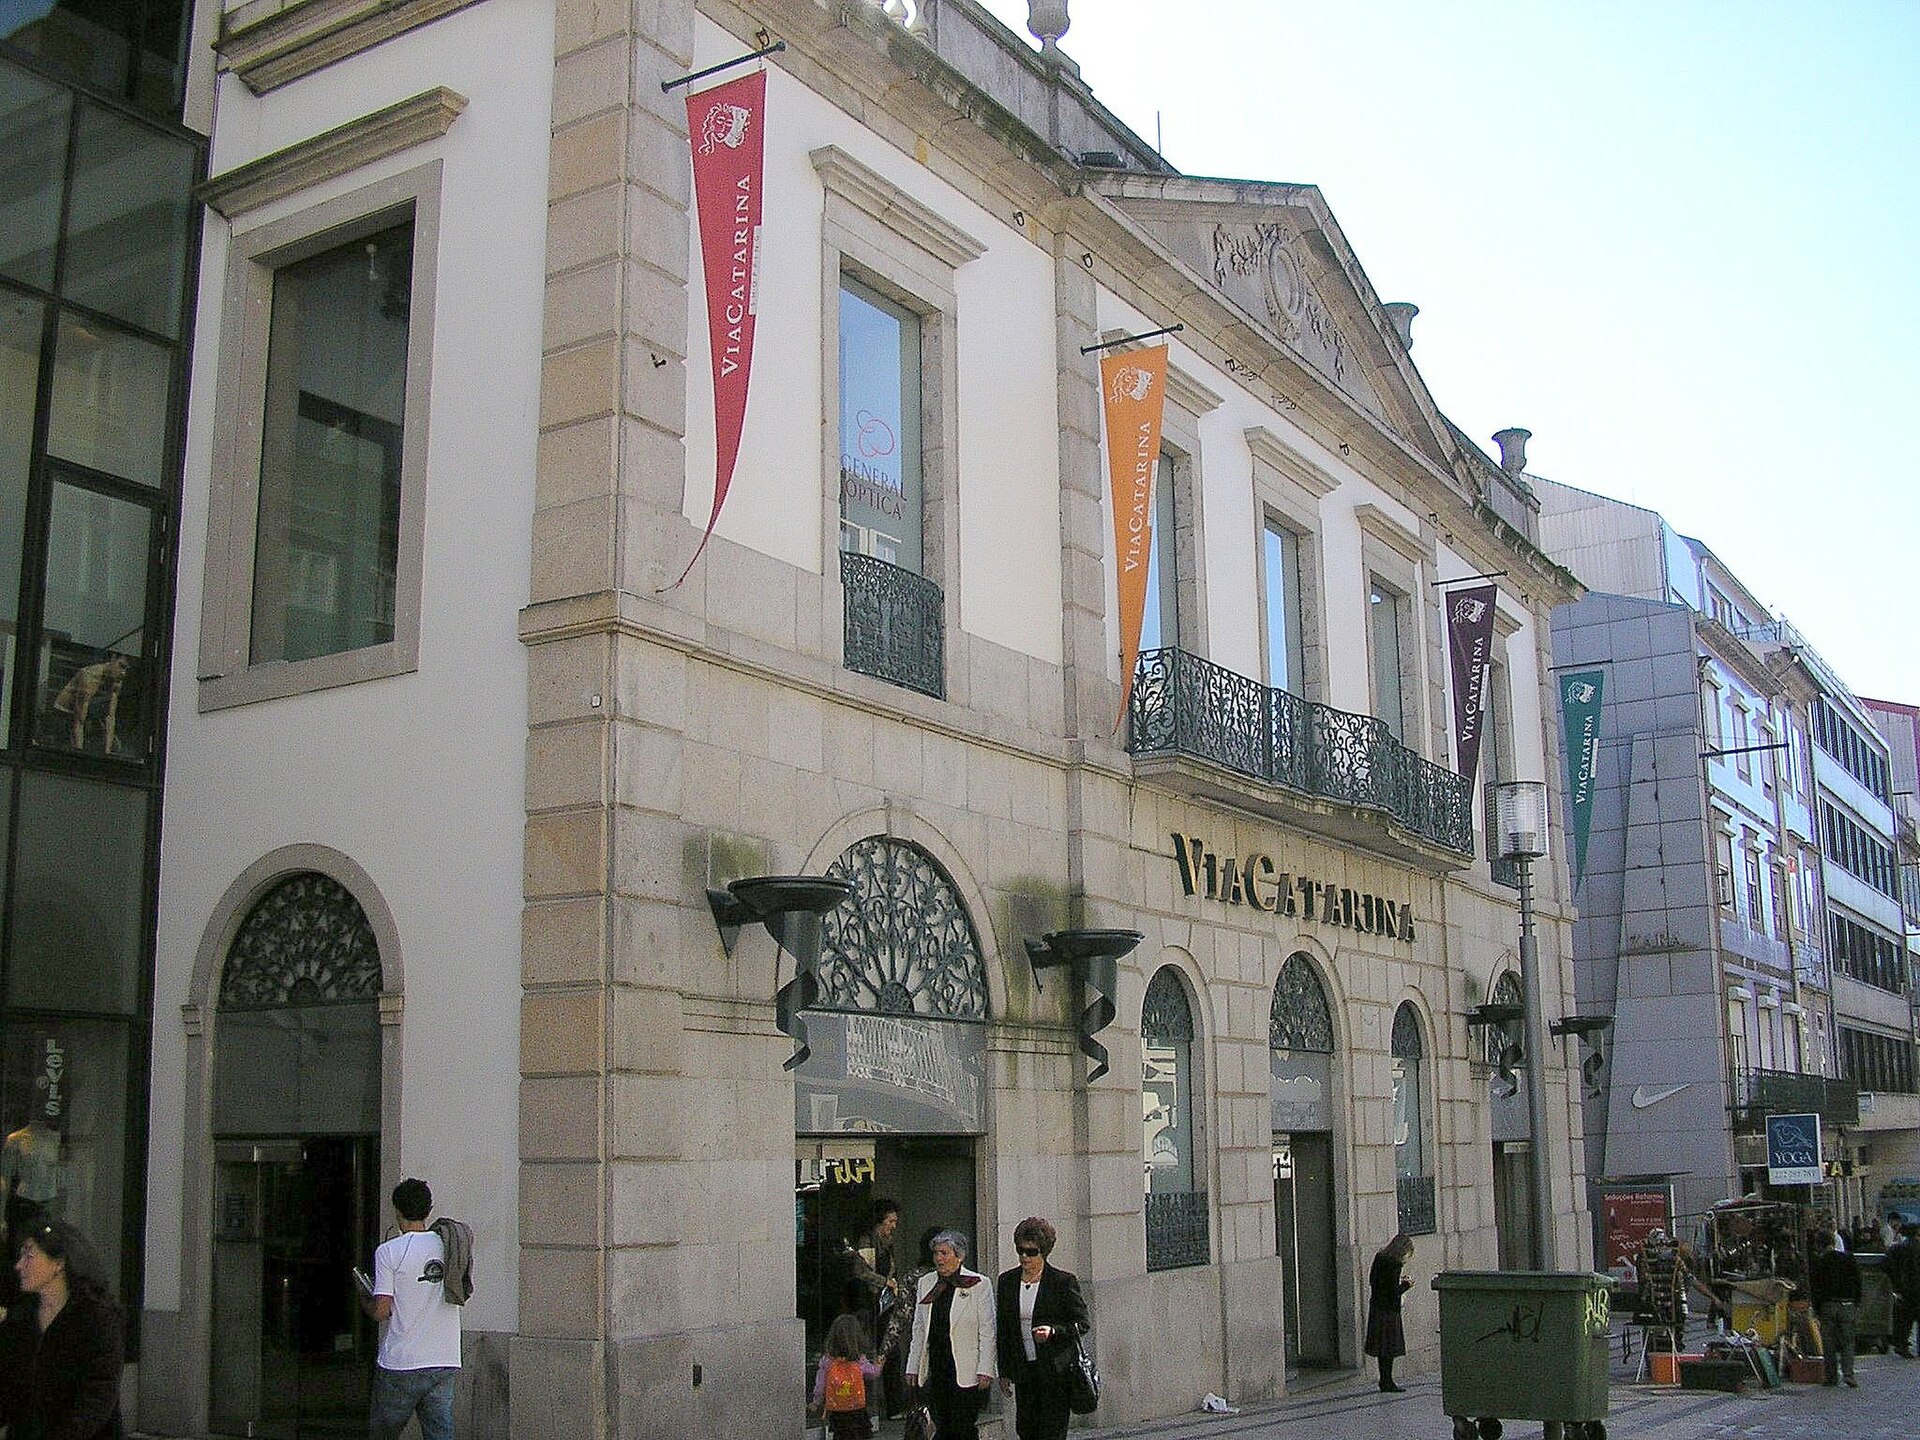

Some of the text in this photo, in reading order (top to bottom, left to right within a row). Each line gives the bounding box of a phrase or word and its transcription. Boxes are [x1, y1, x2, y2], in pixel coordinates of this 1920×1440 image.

[721, 174, 752, 378] VIACATARINA
[840, 454, 907, 502] GENERAL
[844, 479, 902, 520] OPTICA
[1124, 420, 1151, 573] VIACATARINA
[1462, 637, 1485, 743] VIACATARINA
[1170, 832, 1417, 943] VIACATARINA
[1773, 1150, 1813, 1165] YOGA
